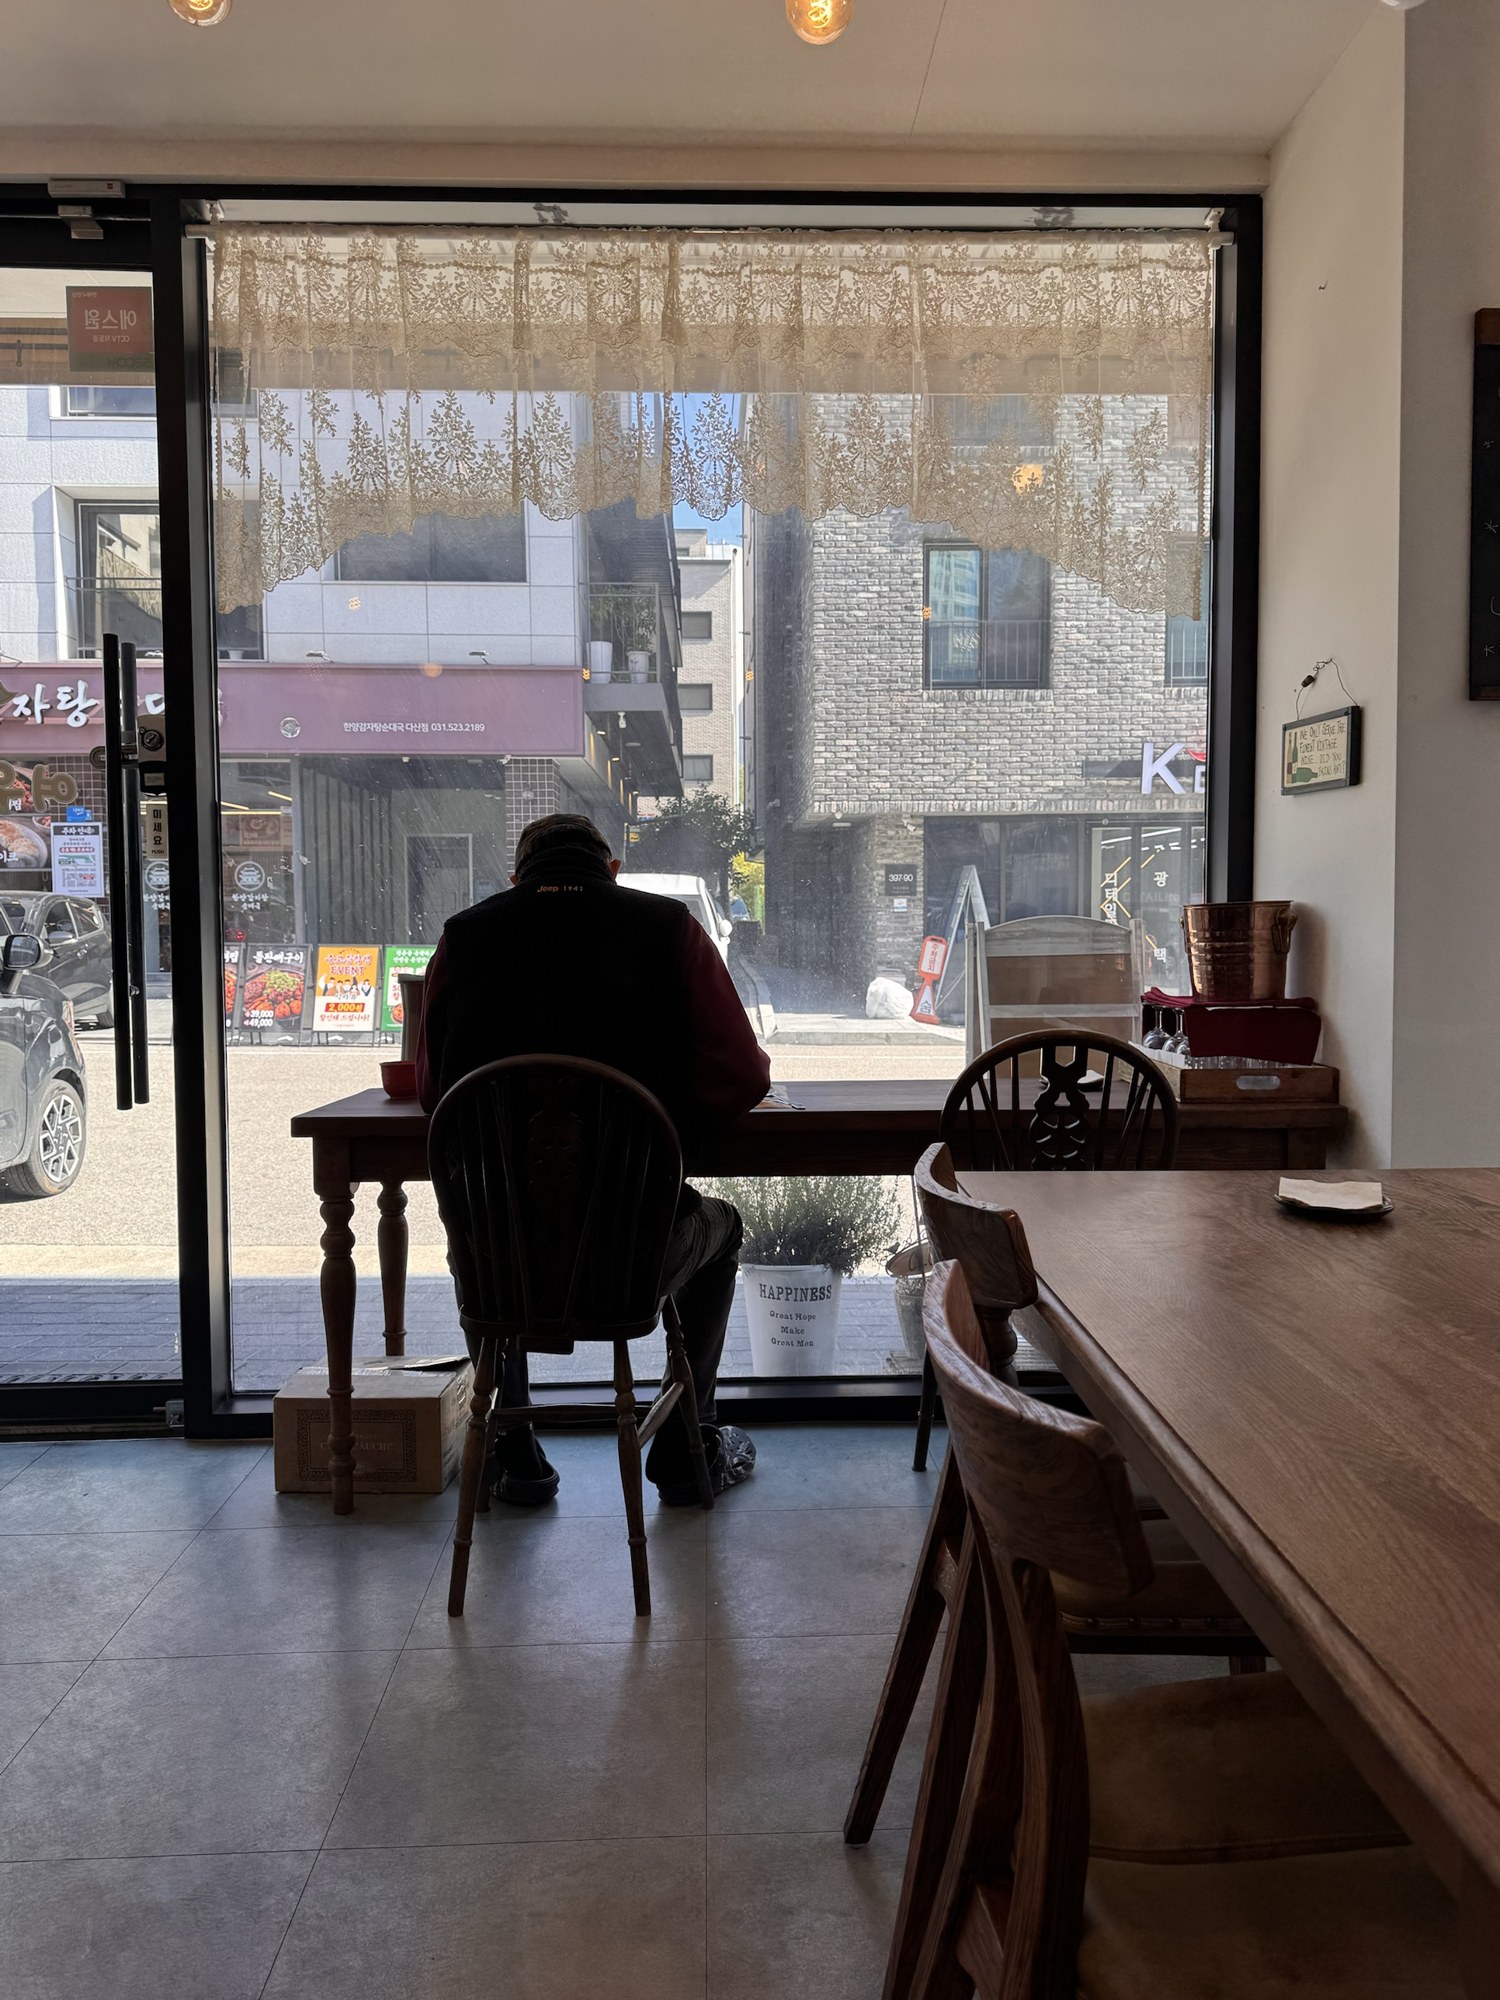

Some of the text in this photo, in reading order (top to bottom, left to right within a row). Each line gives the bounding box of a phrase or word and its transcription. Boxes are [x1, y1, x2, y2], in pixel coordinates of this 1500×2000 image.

[343, 722, 485, 733] 한양감자탕순대국 다산점 031.523.2189
[1300, 720, 1346, 740] WE ONLY SERVE THE
[1299, 738, 1338, 754] FINEST VINTAGE
[1320, 753, 1330, 764] DID
[1332, 752, 1342, 761] YOU
[1318, 766, 1332, 777] BRING
[153, 809, 162, 845] 미세요
[888, 873, 914, 882] 397-90
[330, 966, 365, 976] EVENT
[328, 1003, 363, 1013] 2,000원
[250, 1009, 274, 1019] 39,000
[249, 1018, 274, 1028] 49,000
[759, 1283, 832, 1302] HAPPINESS
[769, 1310, 817, 1322] Great Hope
[780, 1326, 805, 1335] Make
[771, 1337, 795, 1347] Great
